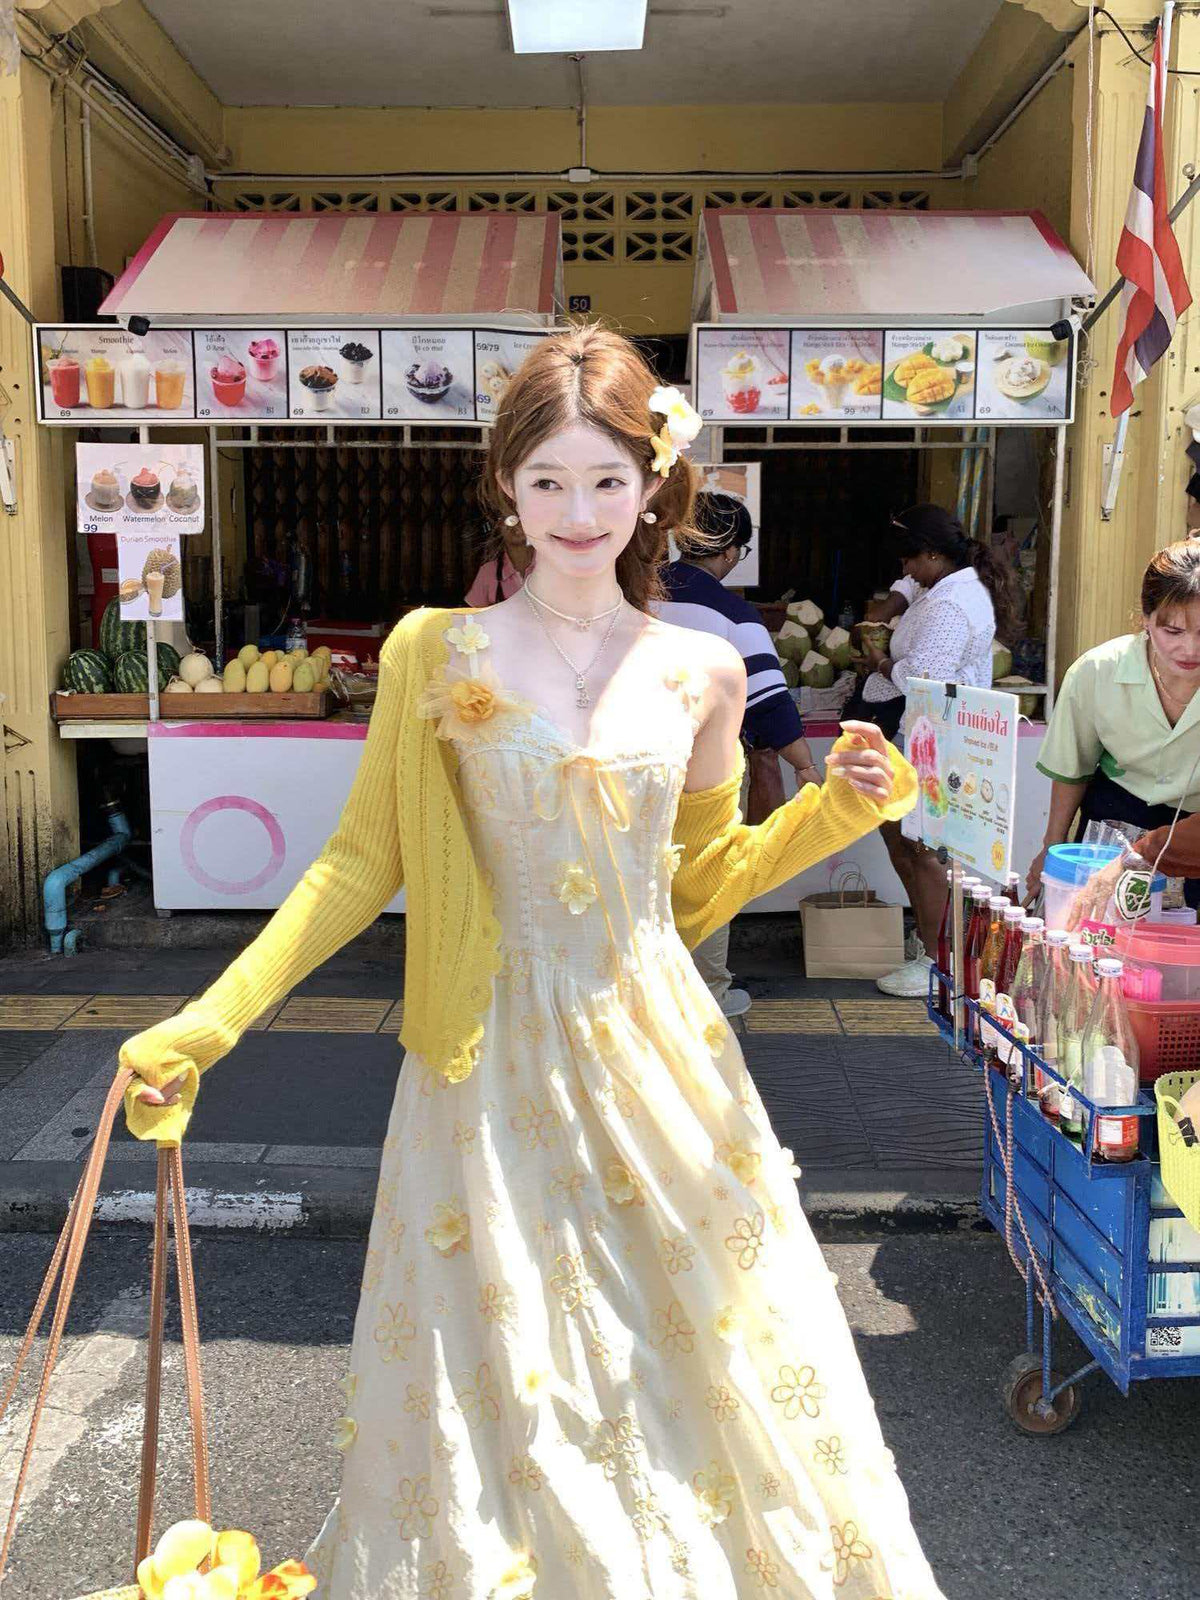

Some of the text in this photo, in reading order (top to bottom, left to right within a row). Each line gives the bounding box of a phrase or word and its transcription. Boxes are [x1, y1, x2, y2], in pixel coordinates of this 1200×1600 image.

[573, 298, 587, 310] 50
[98, 335, 134, 344] Smoothie
[200, 408, 211, 416] 49
[293, 408, 304, 416] 69
[387, 407, 399, 415] 69
[979, 408, 991, 416] 69
[89, 515, 114, 523] Melon
[123, 515, 166, 523] Watermelon
[168, 515, 200, 523] Coconut
[83, 523, 98, 533] 99
[958, 700, 1008, 736] น้ำแข็งใส
